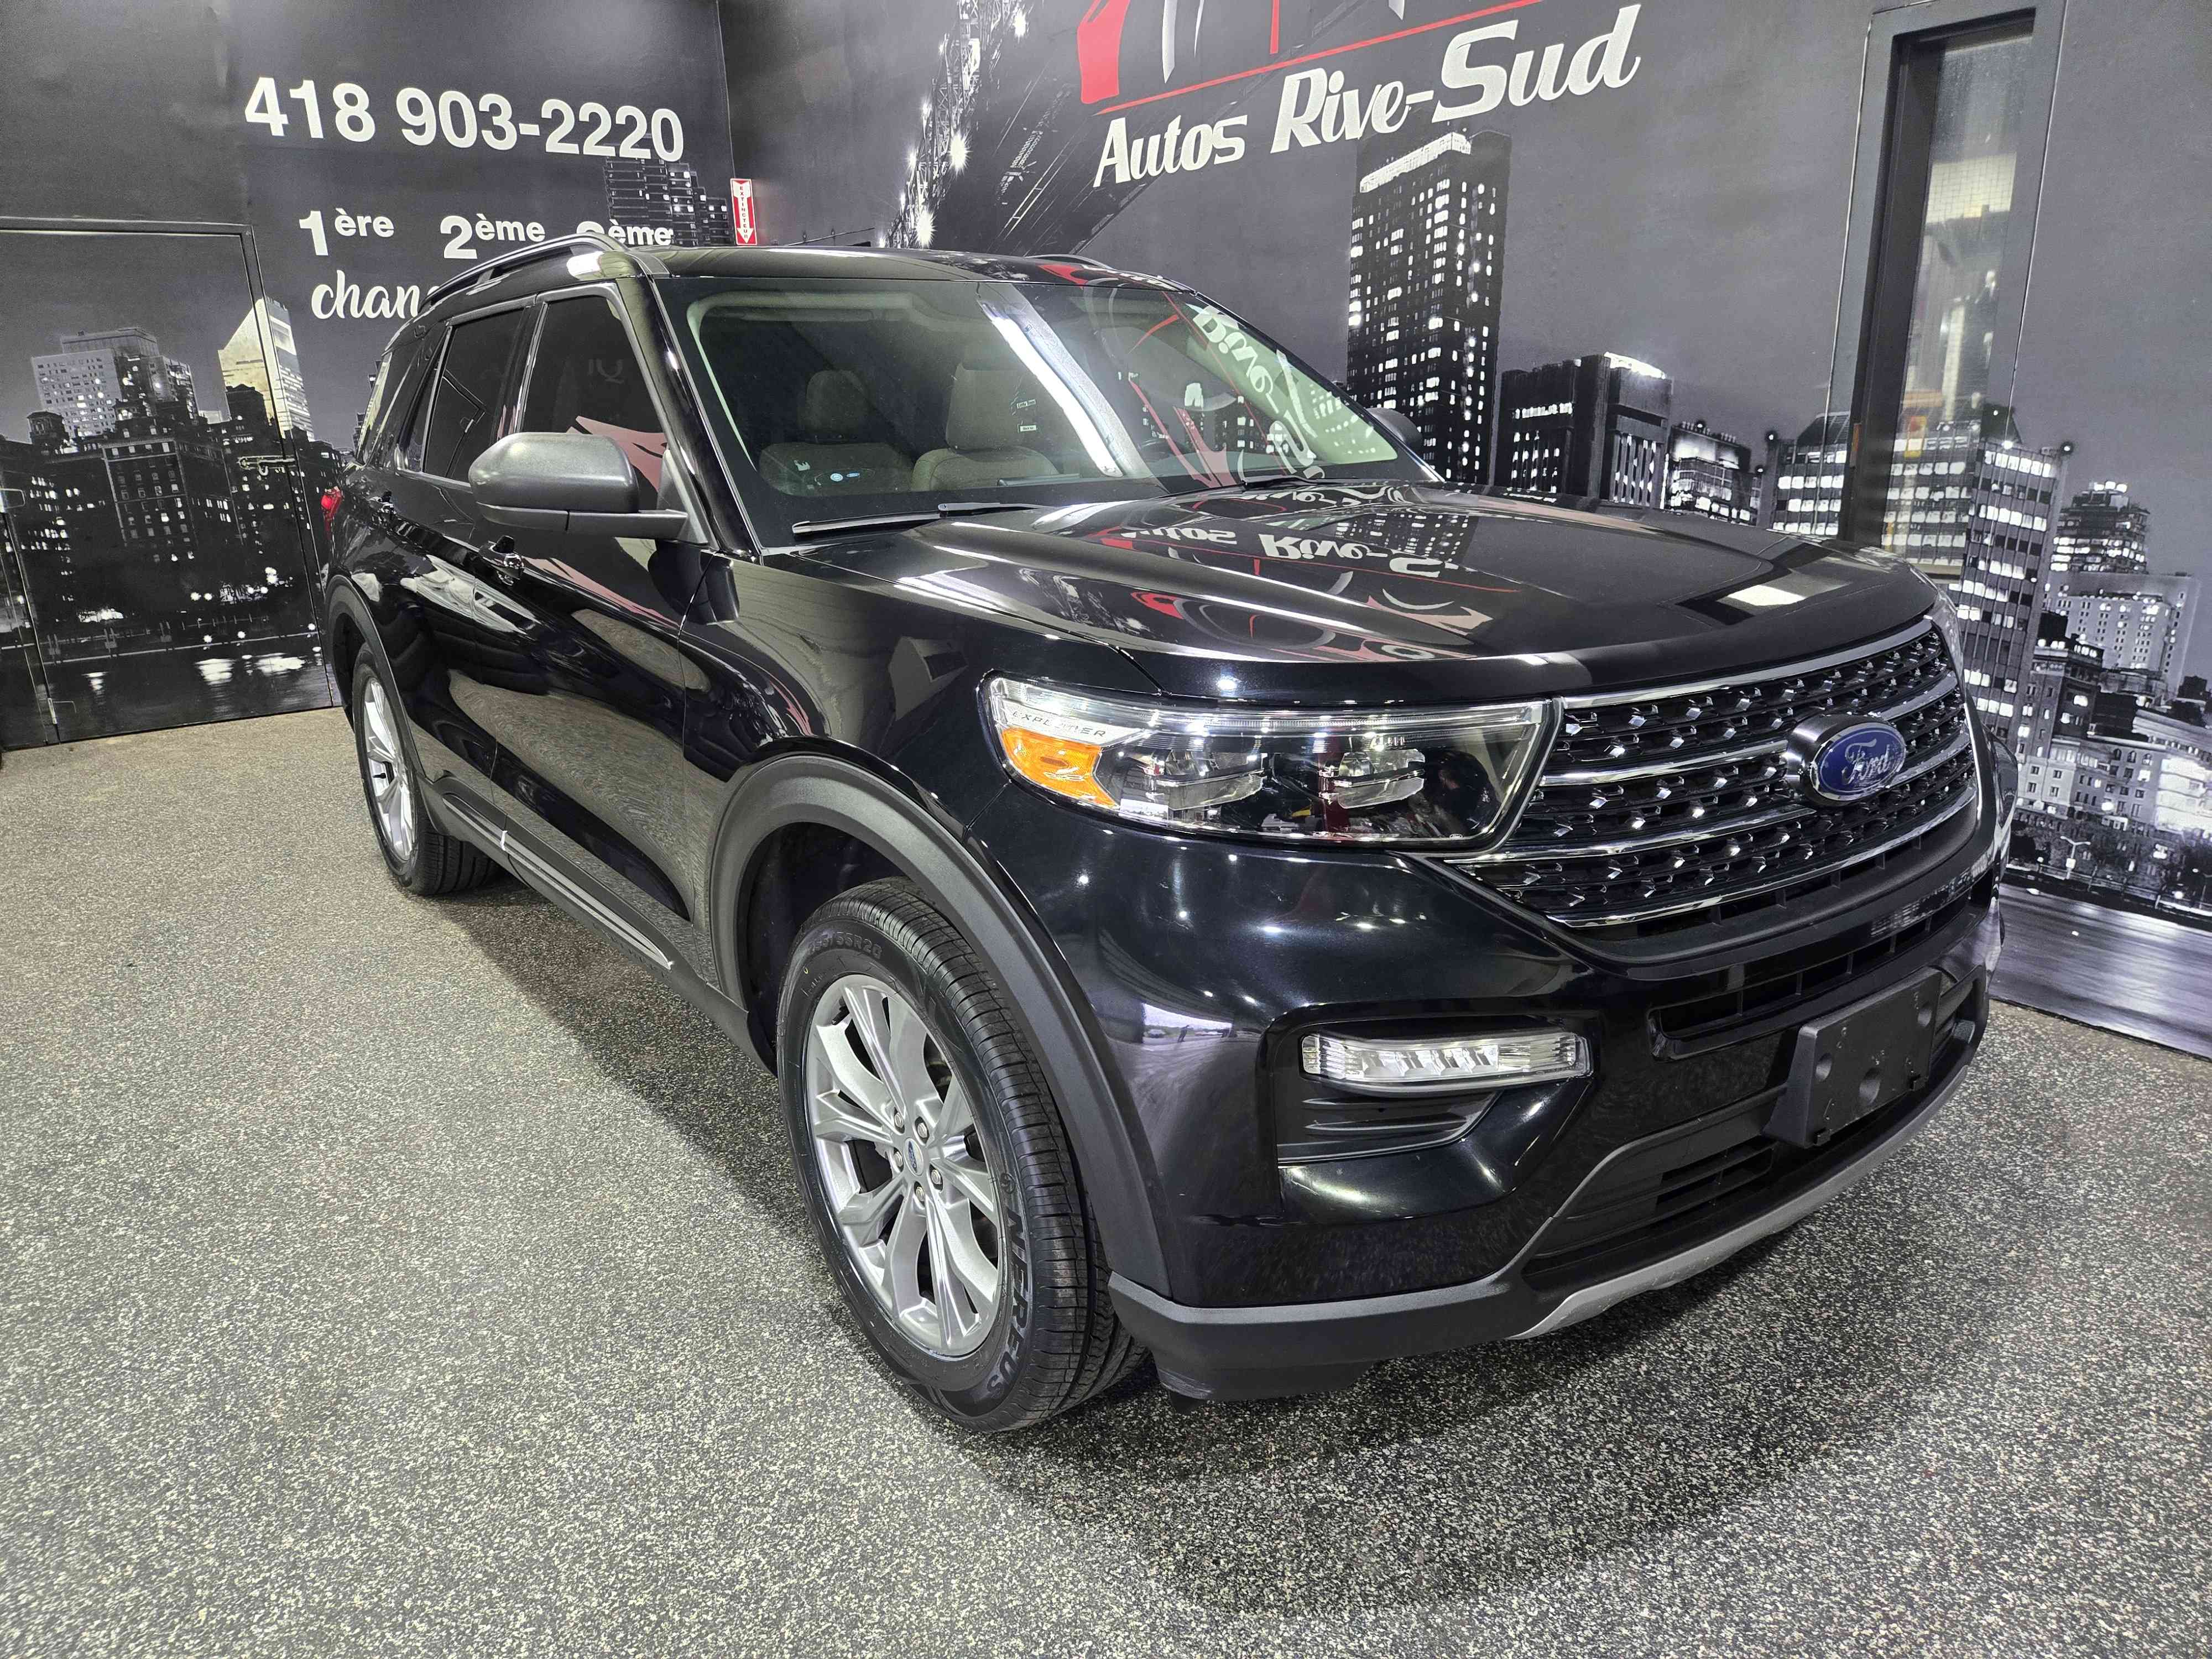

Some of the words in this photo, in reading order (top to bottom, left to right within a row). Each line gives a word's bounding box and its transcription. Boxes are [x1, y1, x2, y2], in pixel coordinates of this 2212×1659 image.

[244, 76, 376, 143] 418
[396, 88, 684, 163] 903-2220
[1093, 114, 1248, 188] Autos
[1270, 4, 1642, 153] Rive-Sud
[739, 186, 748, 238] EXTINCTEUR
[1012, 710, 1107, 738] EXPLRER
[1842, 738, 1891, 785] Ford
[986, 1205, 1029, 1394] NEREUS
